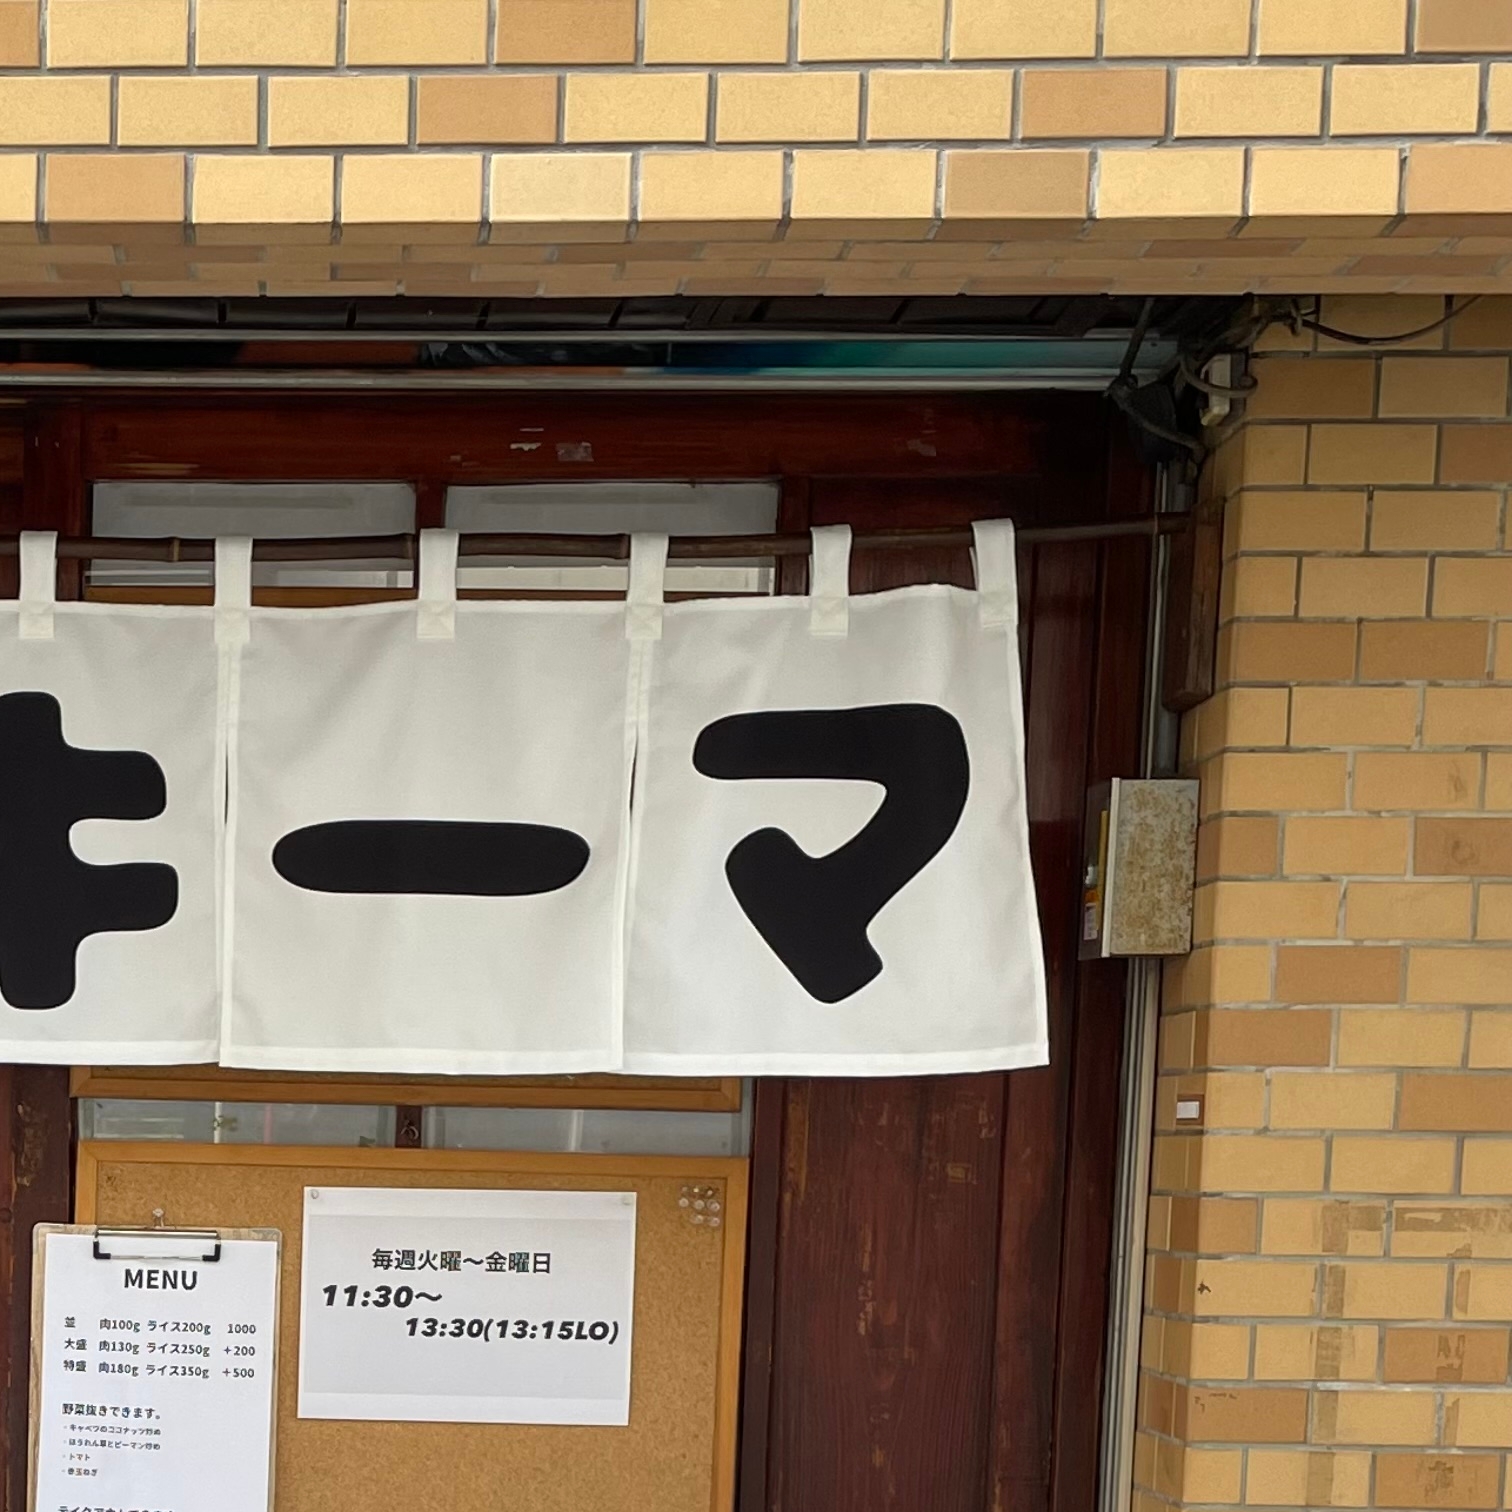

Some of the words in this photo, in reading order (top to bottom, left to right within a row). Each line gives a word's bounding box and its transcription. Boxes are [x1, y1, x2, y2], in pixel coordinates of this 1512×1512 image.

[123, 1268, 198, 1291] MENU
[64, 1316, 76, 1328] 並
[99, 1318, 141, 1333] 肉100g
[147, 1319, 211, 1336] ライス200g
[227, 1323, 257, 1335] 1000
[406, 1317, 619, 1345] 13:30(13:15LO)
[64, 1337, 88, 1351] 大盛
[98, 1339, 140, 1355] 肉130g
[146, 1342, 210, 1358] ライス250g
[223, 1345, 256, 1357] +200
[63, 1359, 87, 1373] 特盛
[98, 1361, 139, 1378] 肉180g
[145, 1364, 210, 1379] ライス350g
[222, 1367, 255, 1379] +500
[61, 1402, 162, 1421] 野菜抜きできます。
